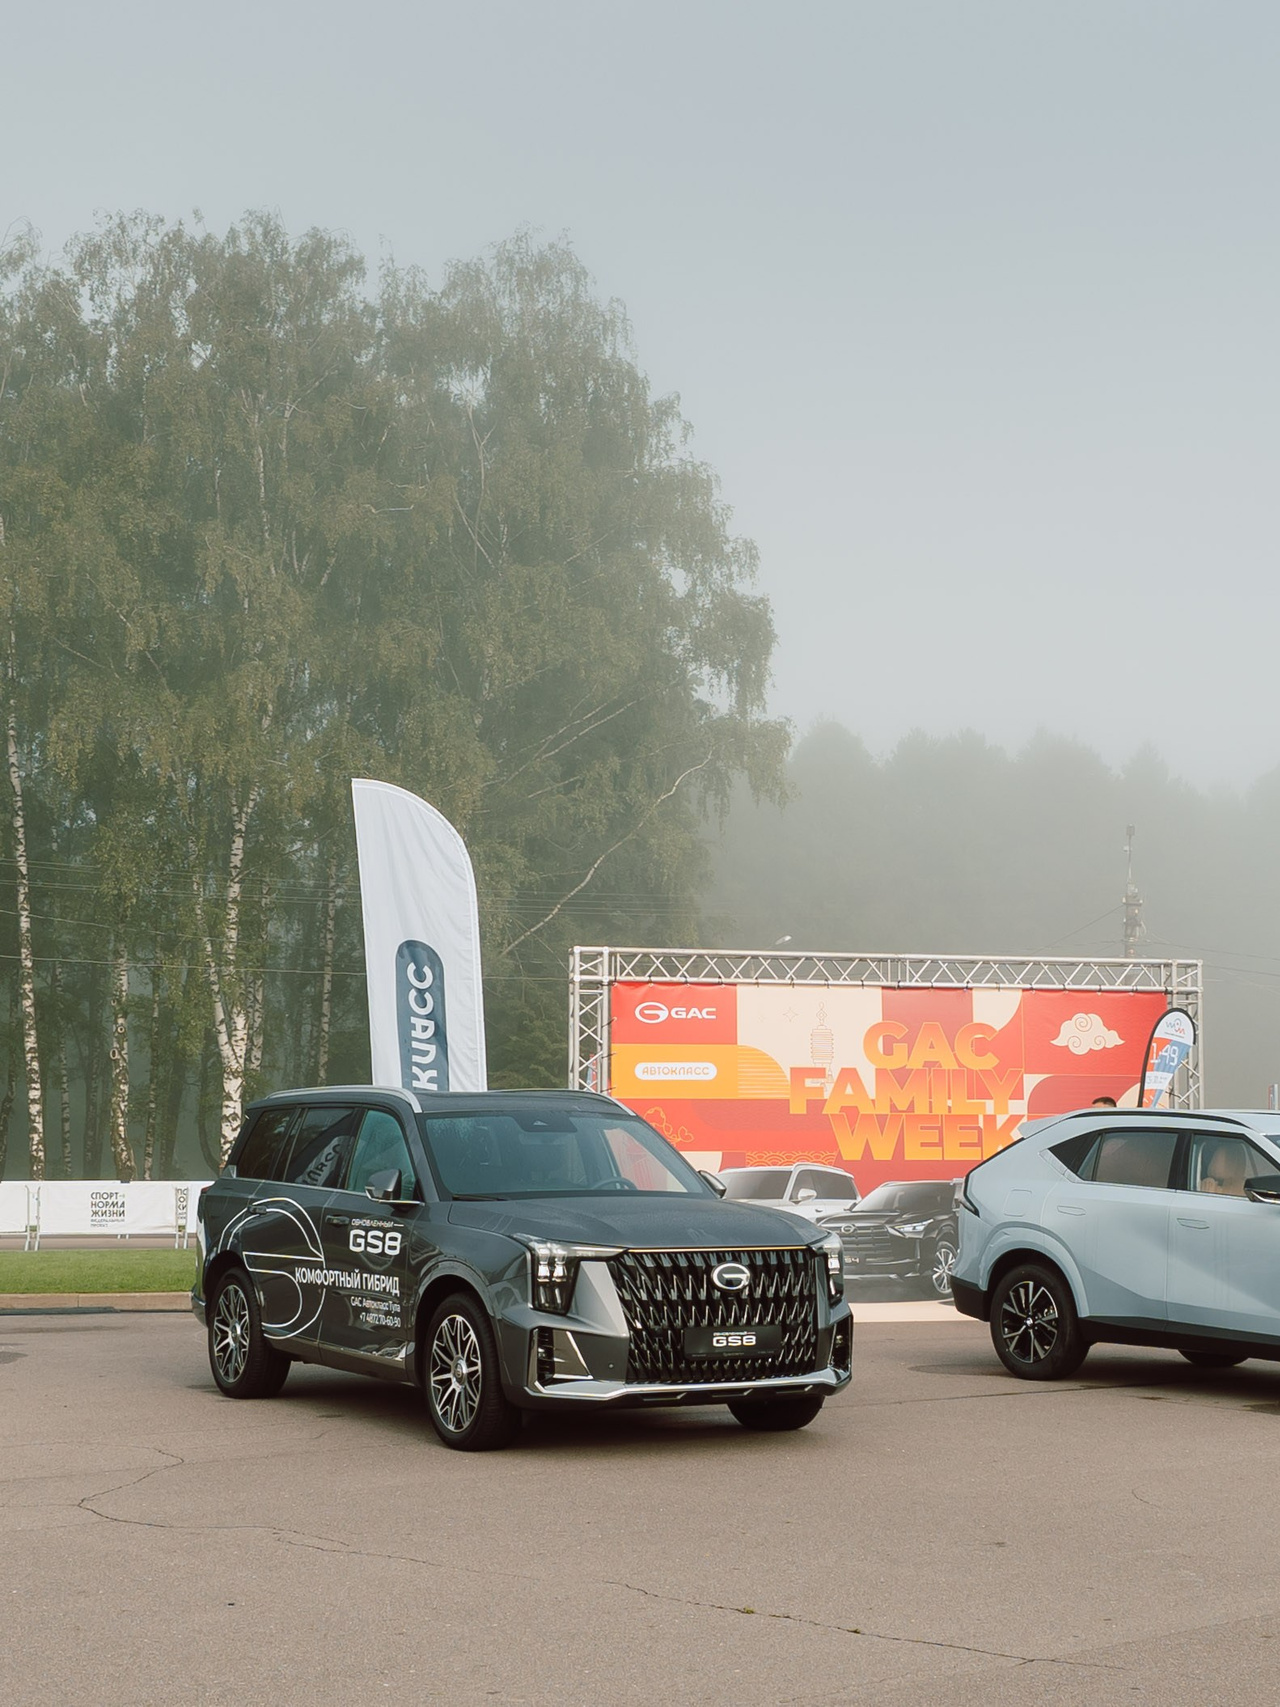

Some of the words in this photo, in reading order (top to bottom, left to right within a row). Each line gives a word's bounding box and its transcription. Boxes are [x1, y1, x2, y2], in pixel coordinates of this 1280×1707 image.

[670, 1007, 717, 1019] GAC
[863, 1020, 1000, 1070] GAC
[642, 1065, 710, 1076] АВТОКЛАСС
[789, 1067, 1024, 1114] FAMILY
[829, 1113, 1028, 1160] WEEK
[91, 1192, 119, 1200] СПОРТ
[91, 1201, 125, 1209] НОРМА
[91, 1209, 125, 1218] ЖИЗНИ
[349, 1229, 402, 1256] GS8
[295, 1267, 361, 1289] КОМФОРТНЫЙ
[362, 1273, 400, 1297] ГИБРИД
[713, 1335, 757, 1347] GS8
